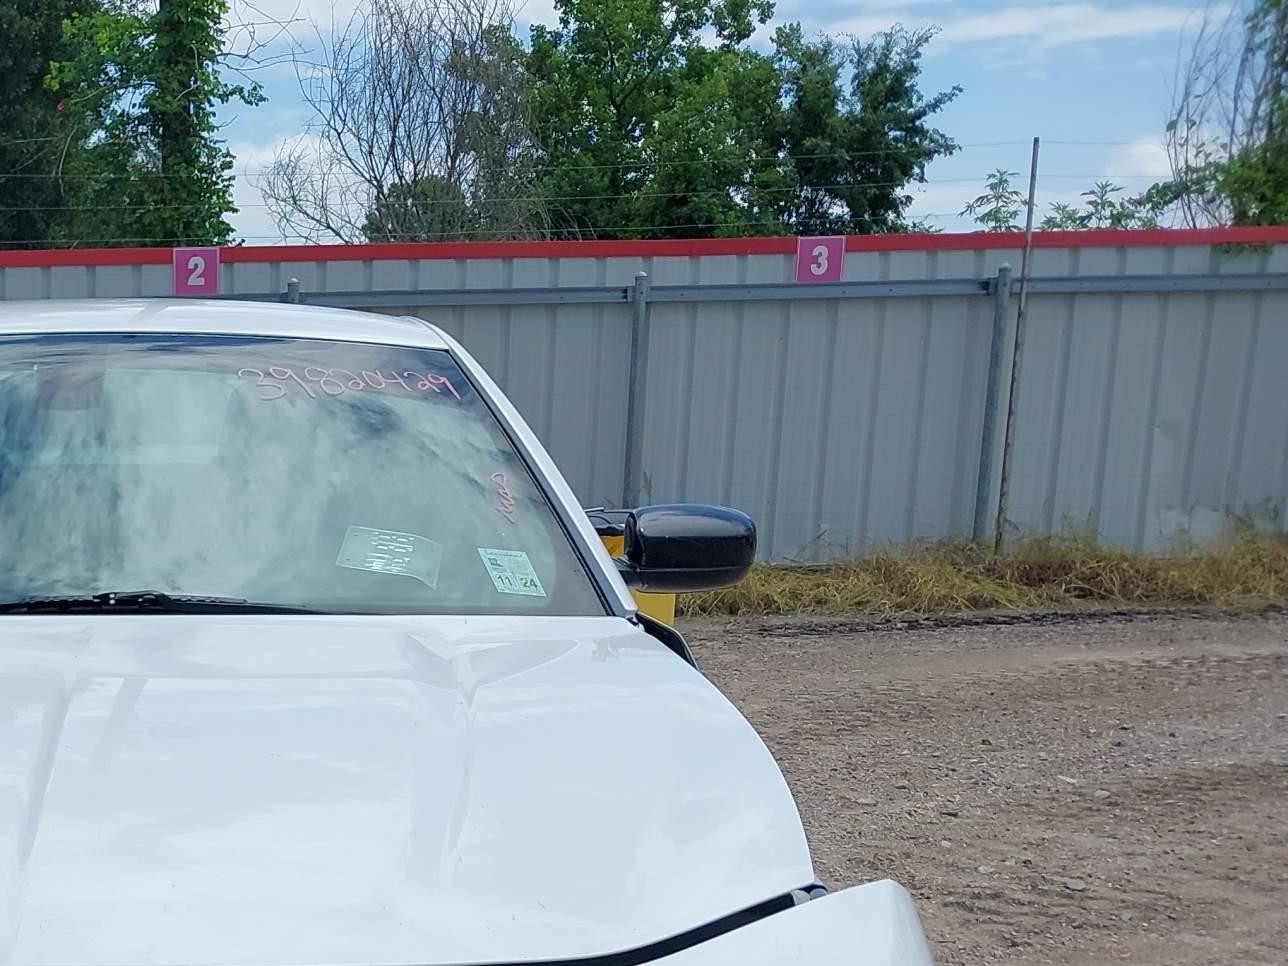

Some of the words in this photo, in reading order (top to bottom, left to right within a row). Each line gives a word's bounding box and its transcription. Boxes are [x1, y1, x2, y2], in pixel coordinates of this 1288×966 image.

[187, 256, 205, 286] 2
[811, 245, 829, 275] 3
[238, 367, 462, 401] 39820429
[497, 575, 513, 588] 11
[520, 576, 538, 590] 24
